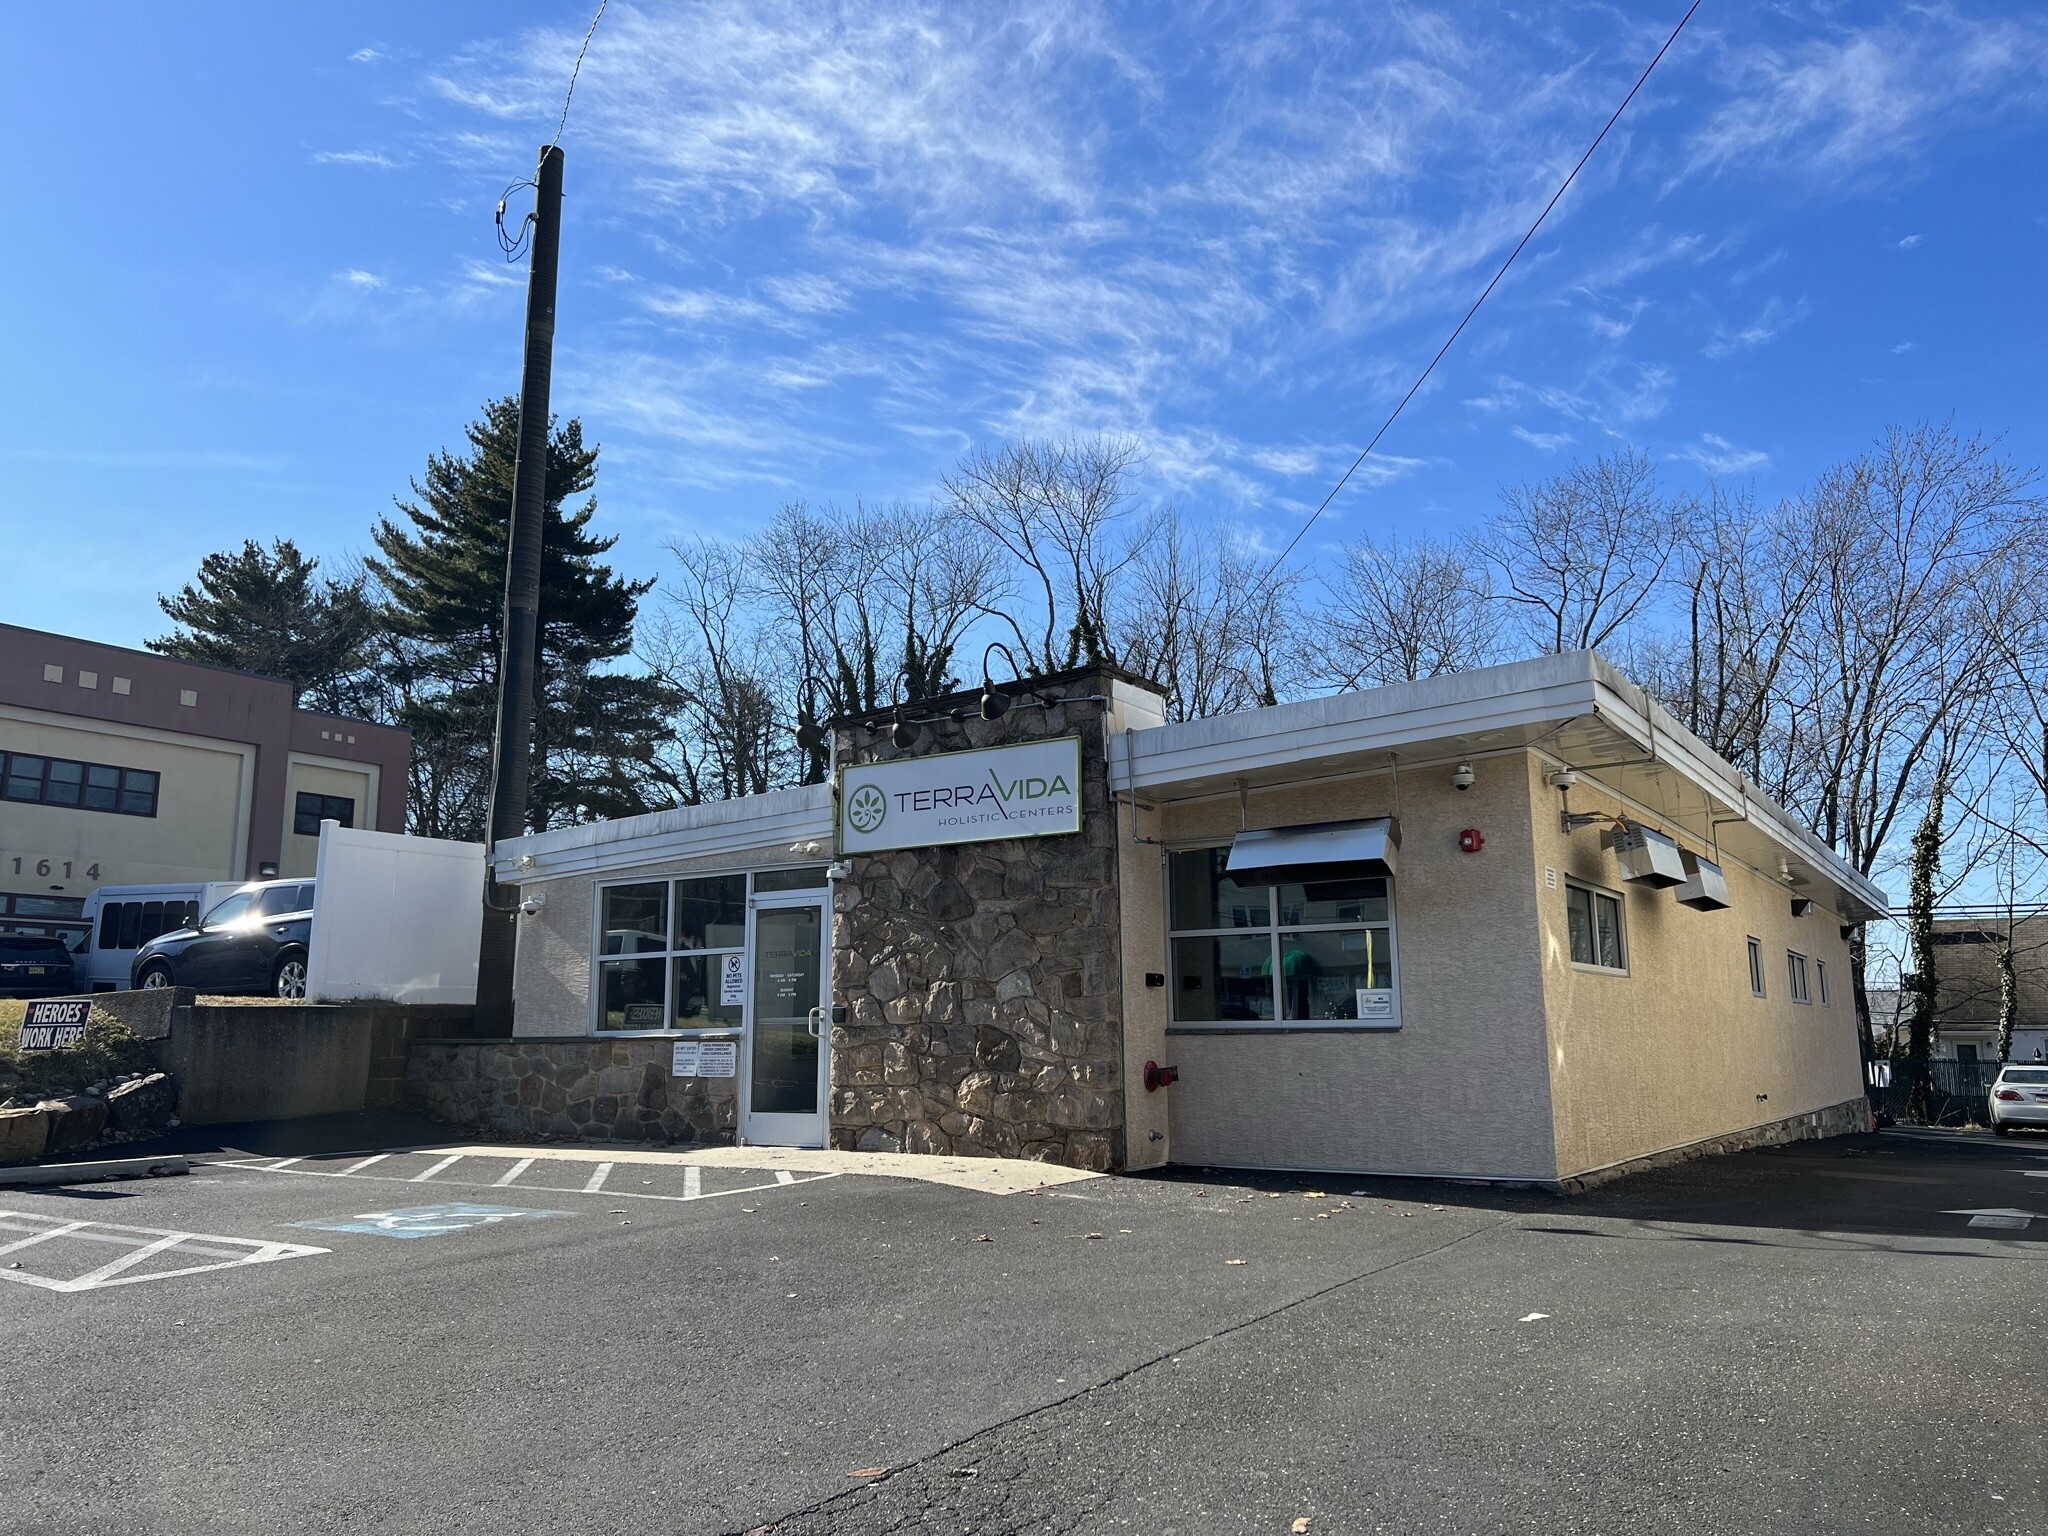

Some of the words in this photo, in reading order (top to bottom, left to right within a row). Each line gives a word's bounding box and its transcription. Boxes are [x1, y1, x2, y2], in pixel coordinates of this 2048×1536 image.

[938, 812, 1000, 827] HOLISTIC
[1008, 805, 1073, 820] CENTERS
[12, 857, 101, 881] 1614
[32, 1003, 82, 1023] HEROES
[21, 1027, 54, 1048] WORK
[53, 1026, 84, 1047] HERE
